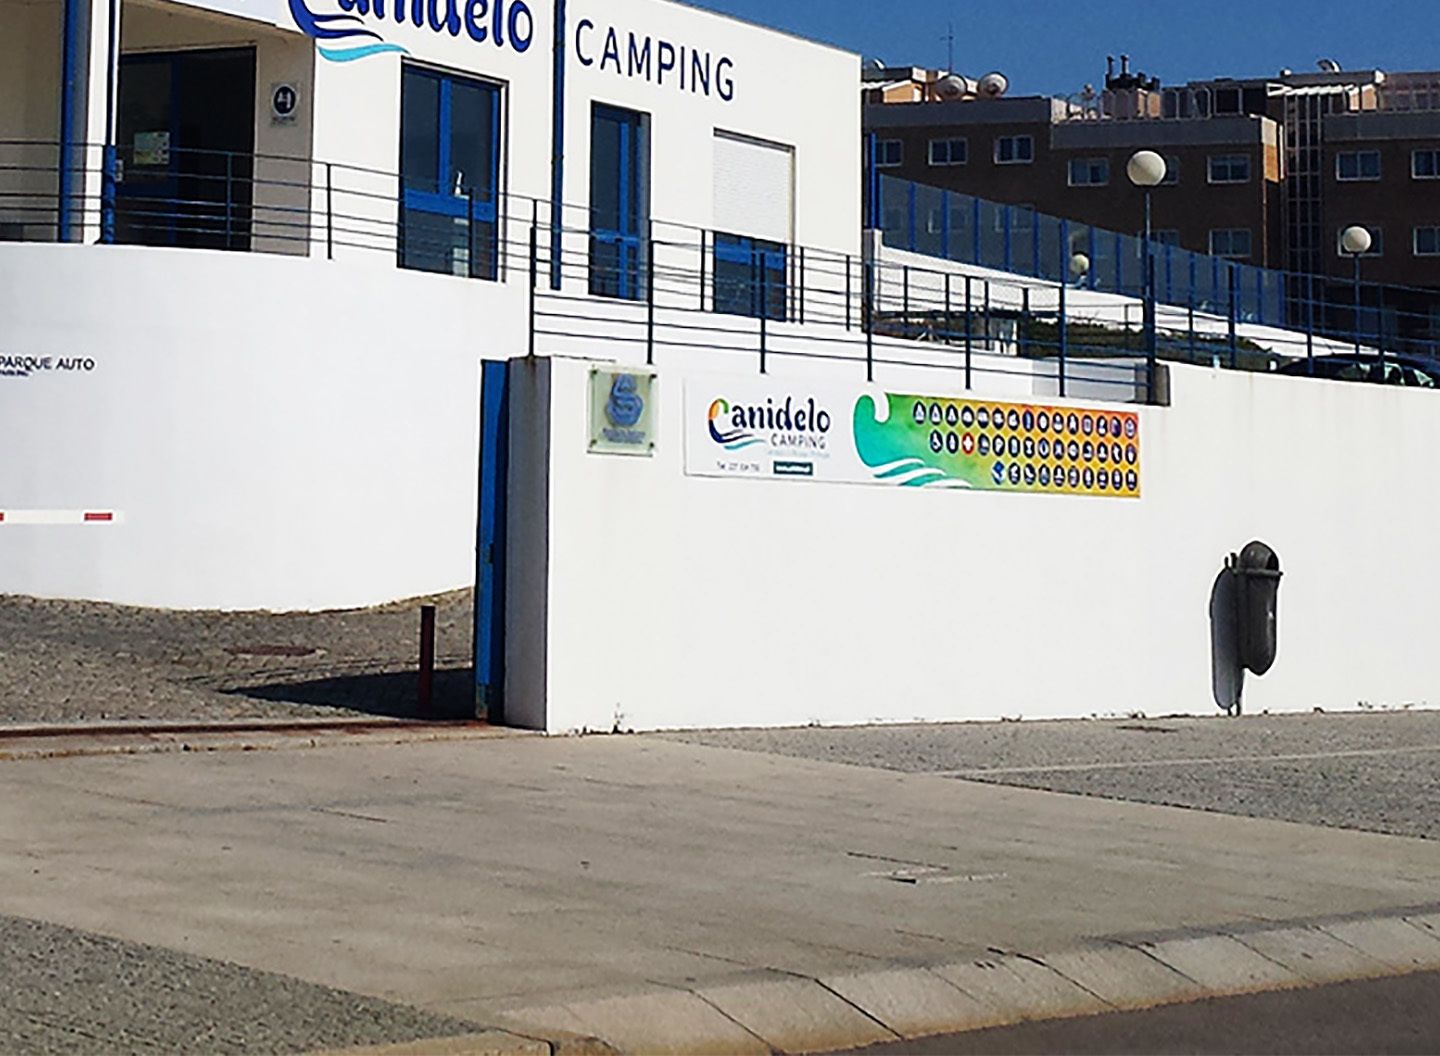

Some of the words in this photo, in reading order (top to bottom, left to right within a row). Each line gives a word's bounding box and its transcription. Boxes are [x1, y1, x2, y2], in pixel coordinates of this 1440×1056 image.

[575, 18, 735, 102] CAMPING
[56, 357, 95, 371] AUTO
[707, 397, 831, 443] Canidelo
[770, 433, 827, 450] CAMPING
